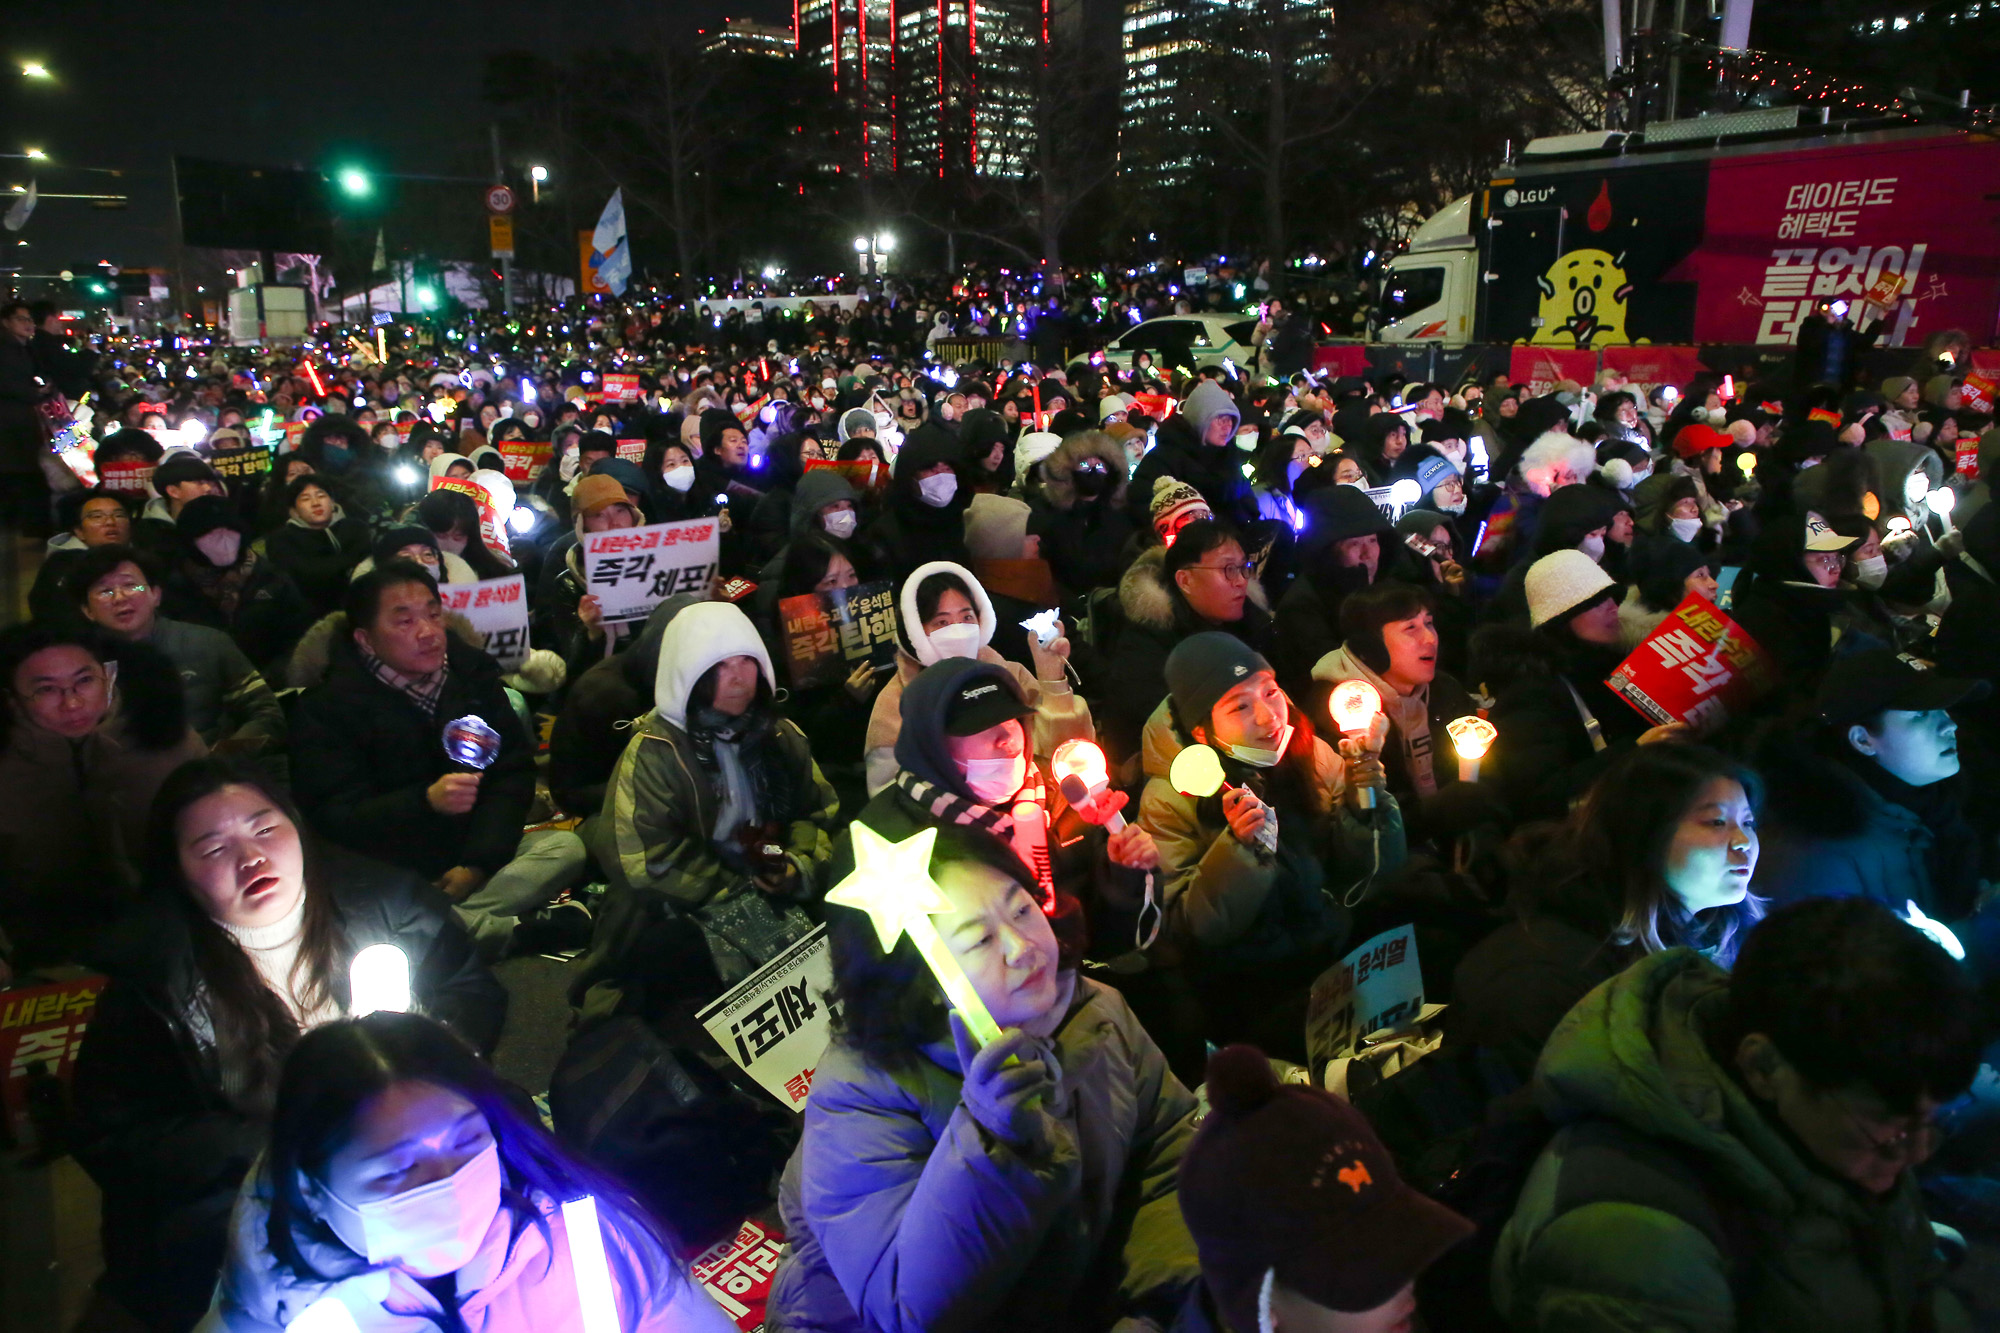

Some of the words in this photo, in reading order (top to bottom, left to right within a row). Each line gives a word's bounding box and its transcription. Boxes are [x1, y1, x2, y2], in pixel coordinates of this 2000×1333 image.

[492, 193, 507, 206] 30
[1785, 177, 1898, 210] 데이터도
[1777, 210, 1860, 239] 혜택도
[1424, 461, 1445, 479] ICEWEAR
[592, 553, 656, 587] 즉각
[645, 562, 717, 598] 체포!
[860, 590, 893, 615] 윤석열
[792, 627, 839, 660] 즉각
[840, 606, 897, 661] 탄핵
[1647, 628, 1732, 695] 즉각
[962, 684, 998, 699] Supreme
[1357, 935, 1408, 985] 윤석열
[730, 975, 818, 1068] 체포!
